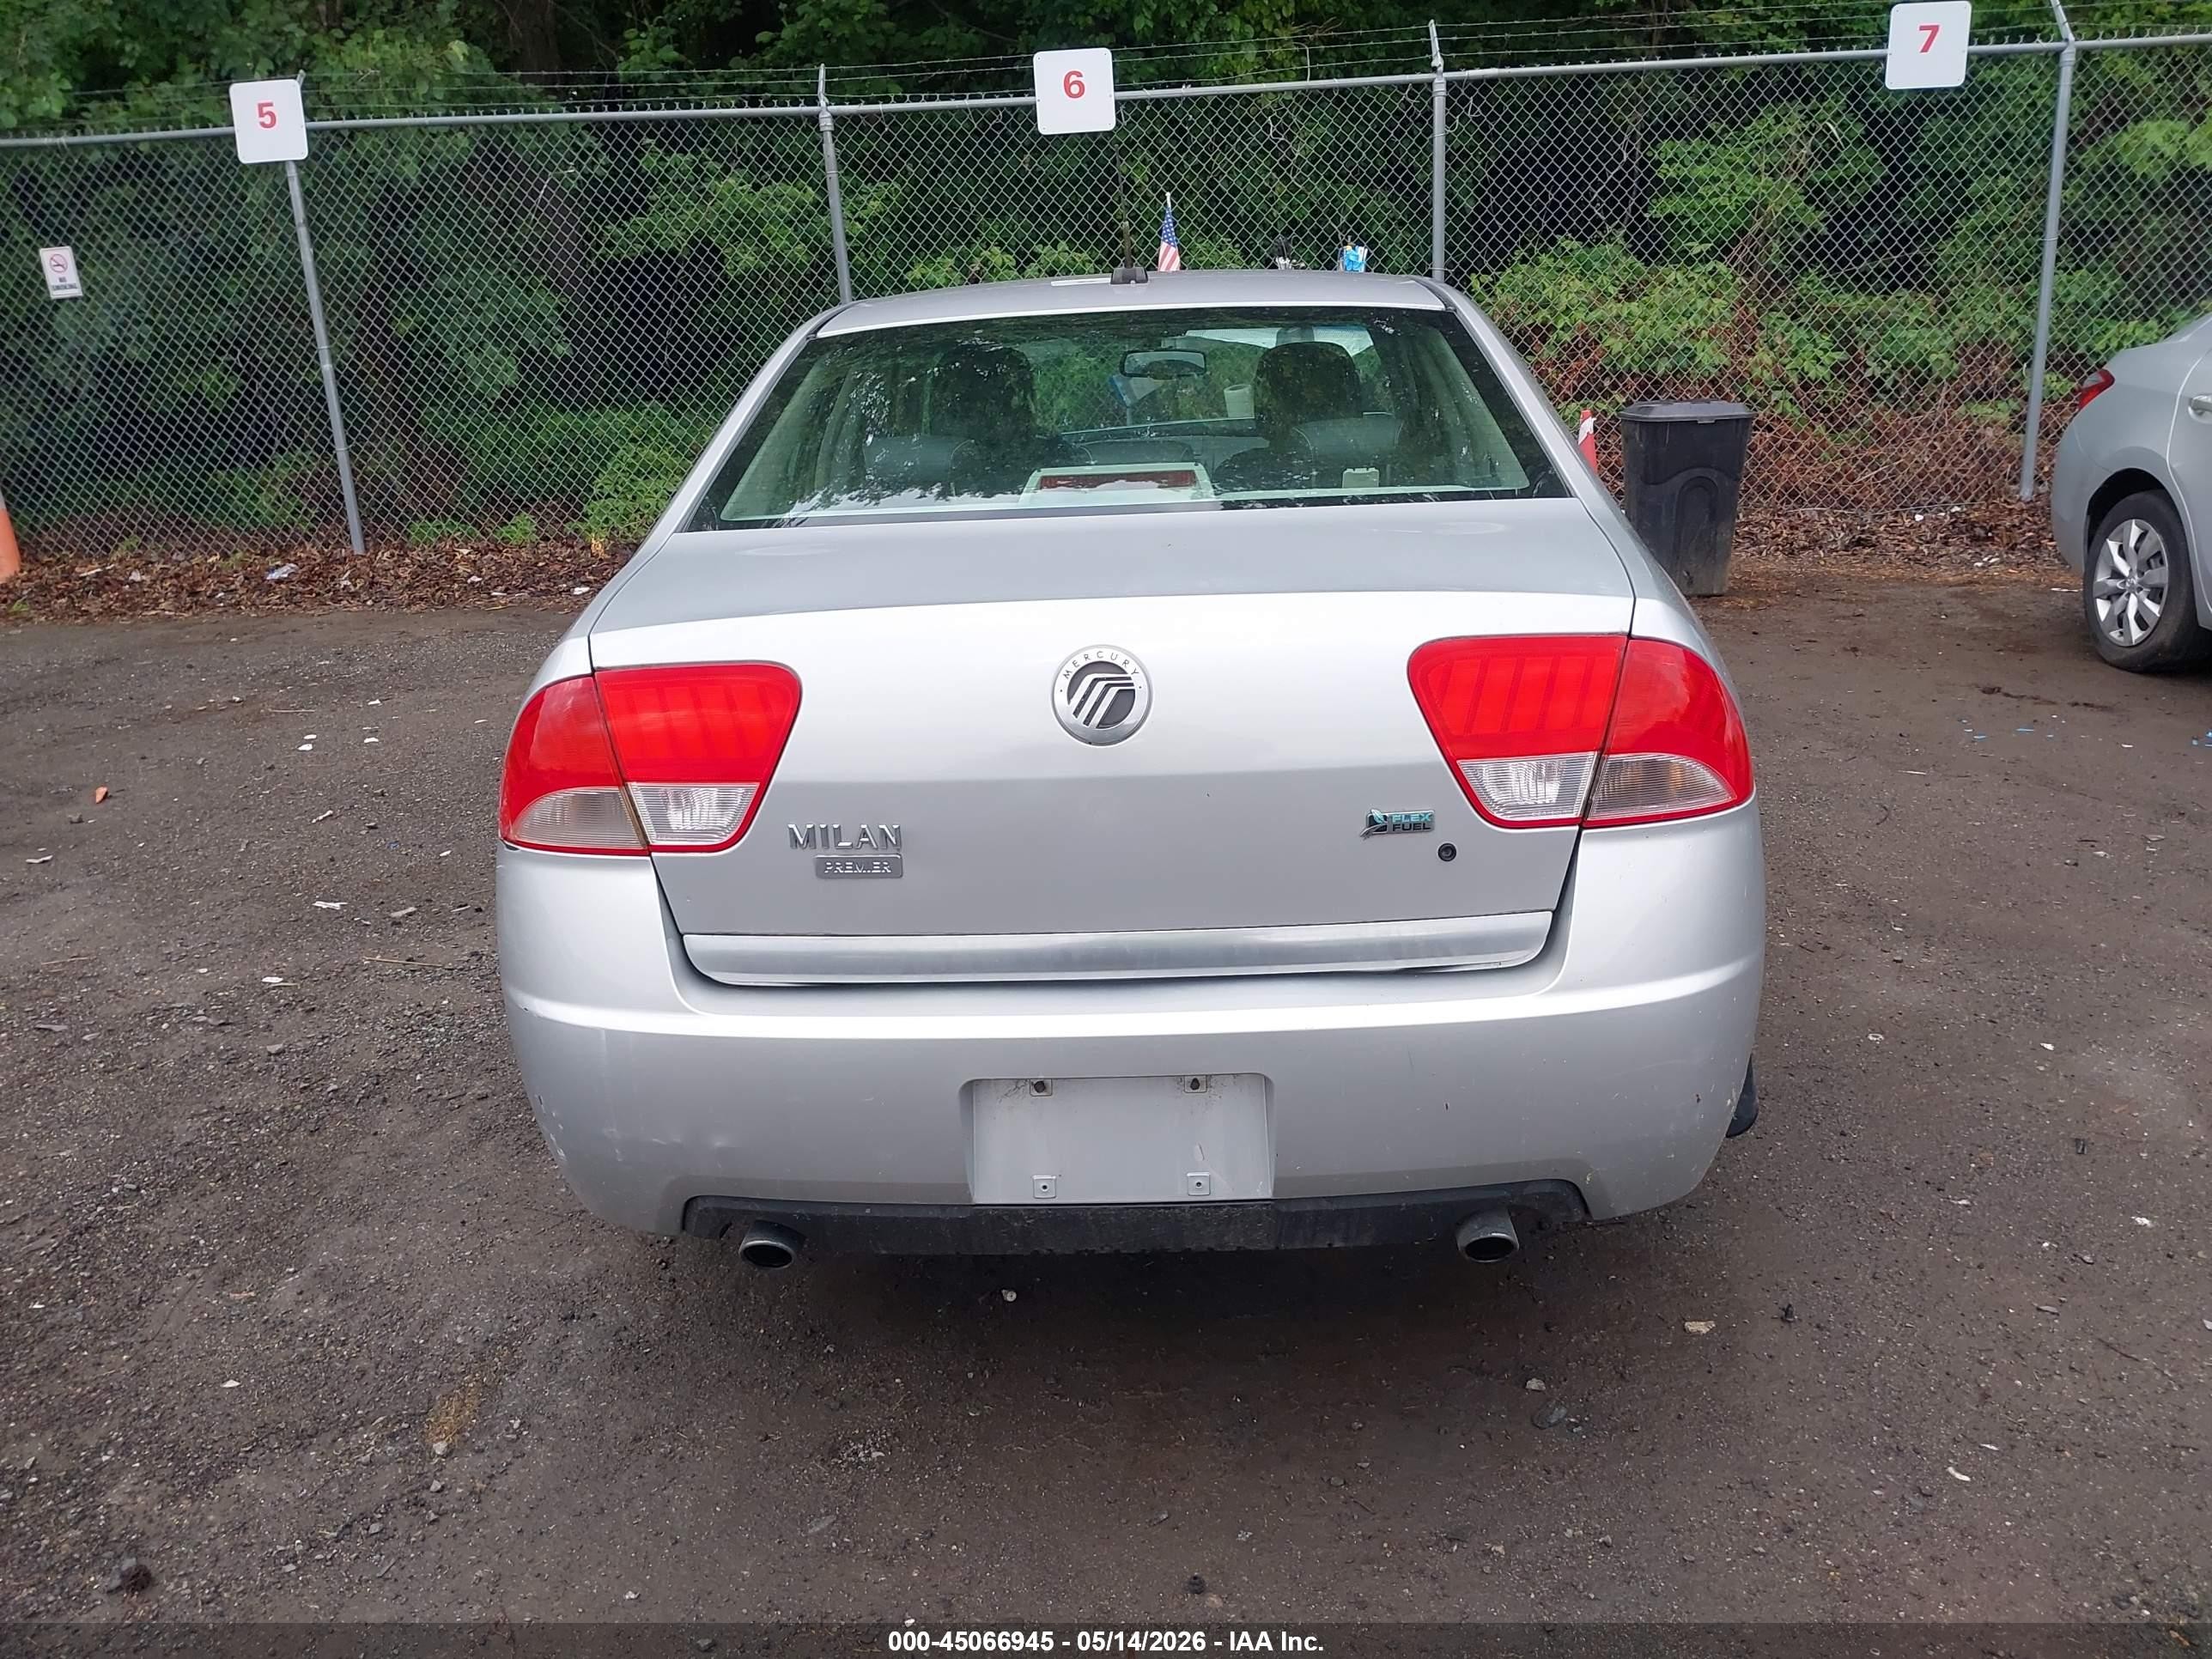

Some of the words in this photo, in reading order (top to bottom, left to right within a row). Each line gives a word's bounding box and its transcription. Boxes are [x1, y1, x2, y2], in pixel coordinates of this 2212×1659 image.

[1919, 24, 1940, 53] 7
[1063, 70, 1085, 99] 6
[258, 102, 276, 129] 5
[1062, 650, 1140, 680] MERCURY
[1392, 812, 1432, 823] FLEX
[1392, 823, 1432, 832] FUEL
[787, 823, 902, 850] MILAN
[823, 861, 893, 874] PREMIER
